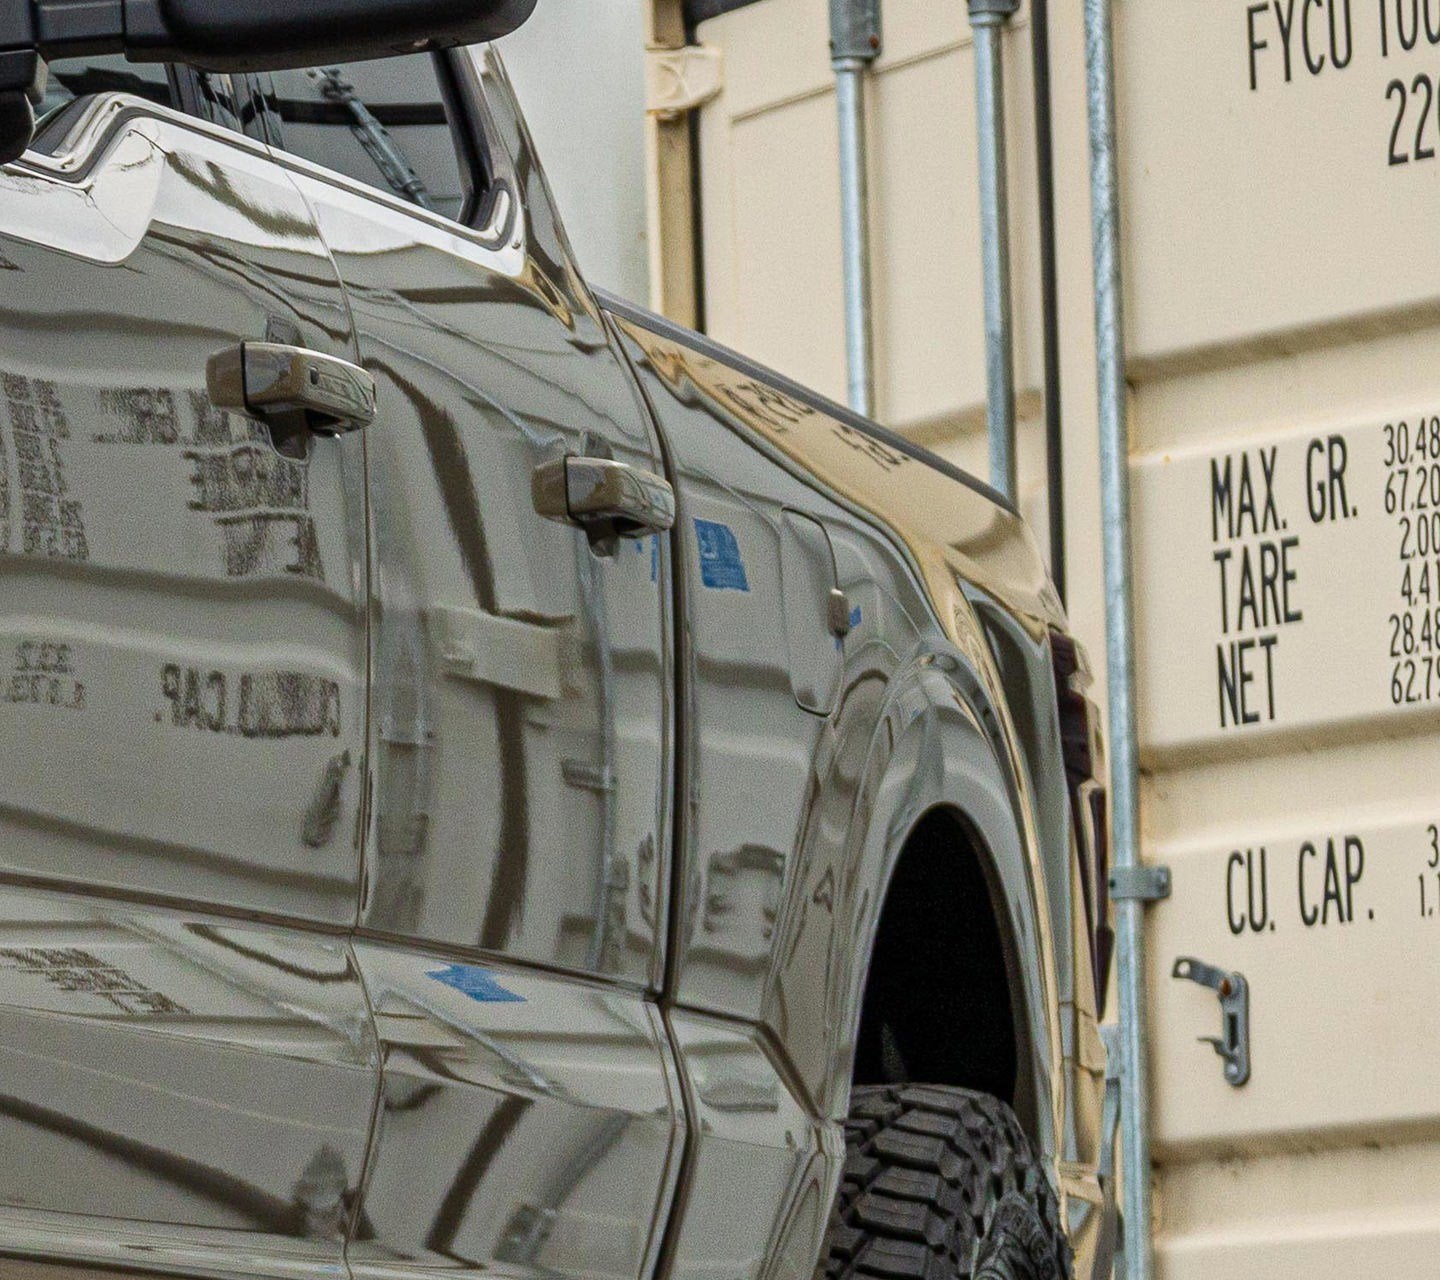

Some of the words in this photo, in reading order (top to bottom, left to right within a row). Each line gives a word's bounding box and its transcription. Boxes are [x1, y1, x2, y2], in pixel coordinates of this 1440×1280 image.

[1385, 72, 1440, 166] 22
[1211, 445, 1287, 542] MAX.
[1306, 433, 1358, 524] GR.
[1213, 535, 1303, 634] TARE
[1217, 634, 1278, 728] NET
[1226, 846, 1275, 935] CU.
[1298, 835, 1374, 927] CAP.
